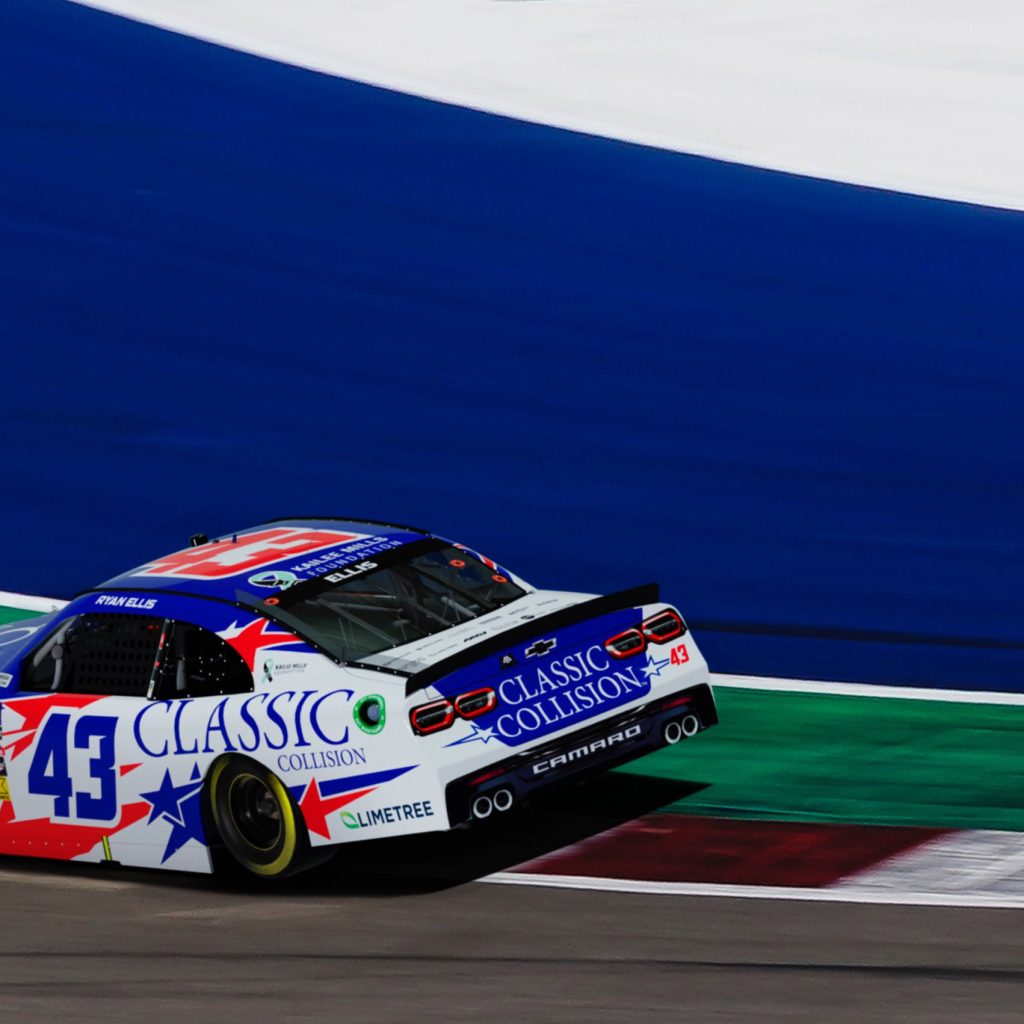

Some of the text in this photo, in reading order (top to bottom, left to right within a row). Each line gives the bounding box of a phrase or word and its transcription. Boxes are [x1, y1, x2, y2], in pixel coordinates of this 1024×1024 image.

[290, 536, 389, 572] KAILEE MILLS
[307, 540, 403, 576] FOUNDATION
[324, 561, 378, 583] ELLIS
[95, 595, 158, 610] RYAN ELLIS
[669, 644, 689, 666] 43
[498, 645, 610, 705] CLASSIC
[497, 666, 643, 738] COLLISION
[133, 689, 355, 758] CLASSIC
[28, 712, 119, 821] 43
[277, 748, 367, 772] COLLISION
[533, 725, 641, 775] CAMARO
[357, 800, 434, 828] LIMETREE
